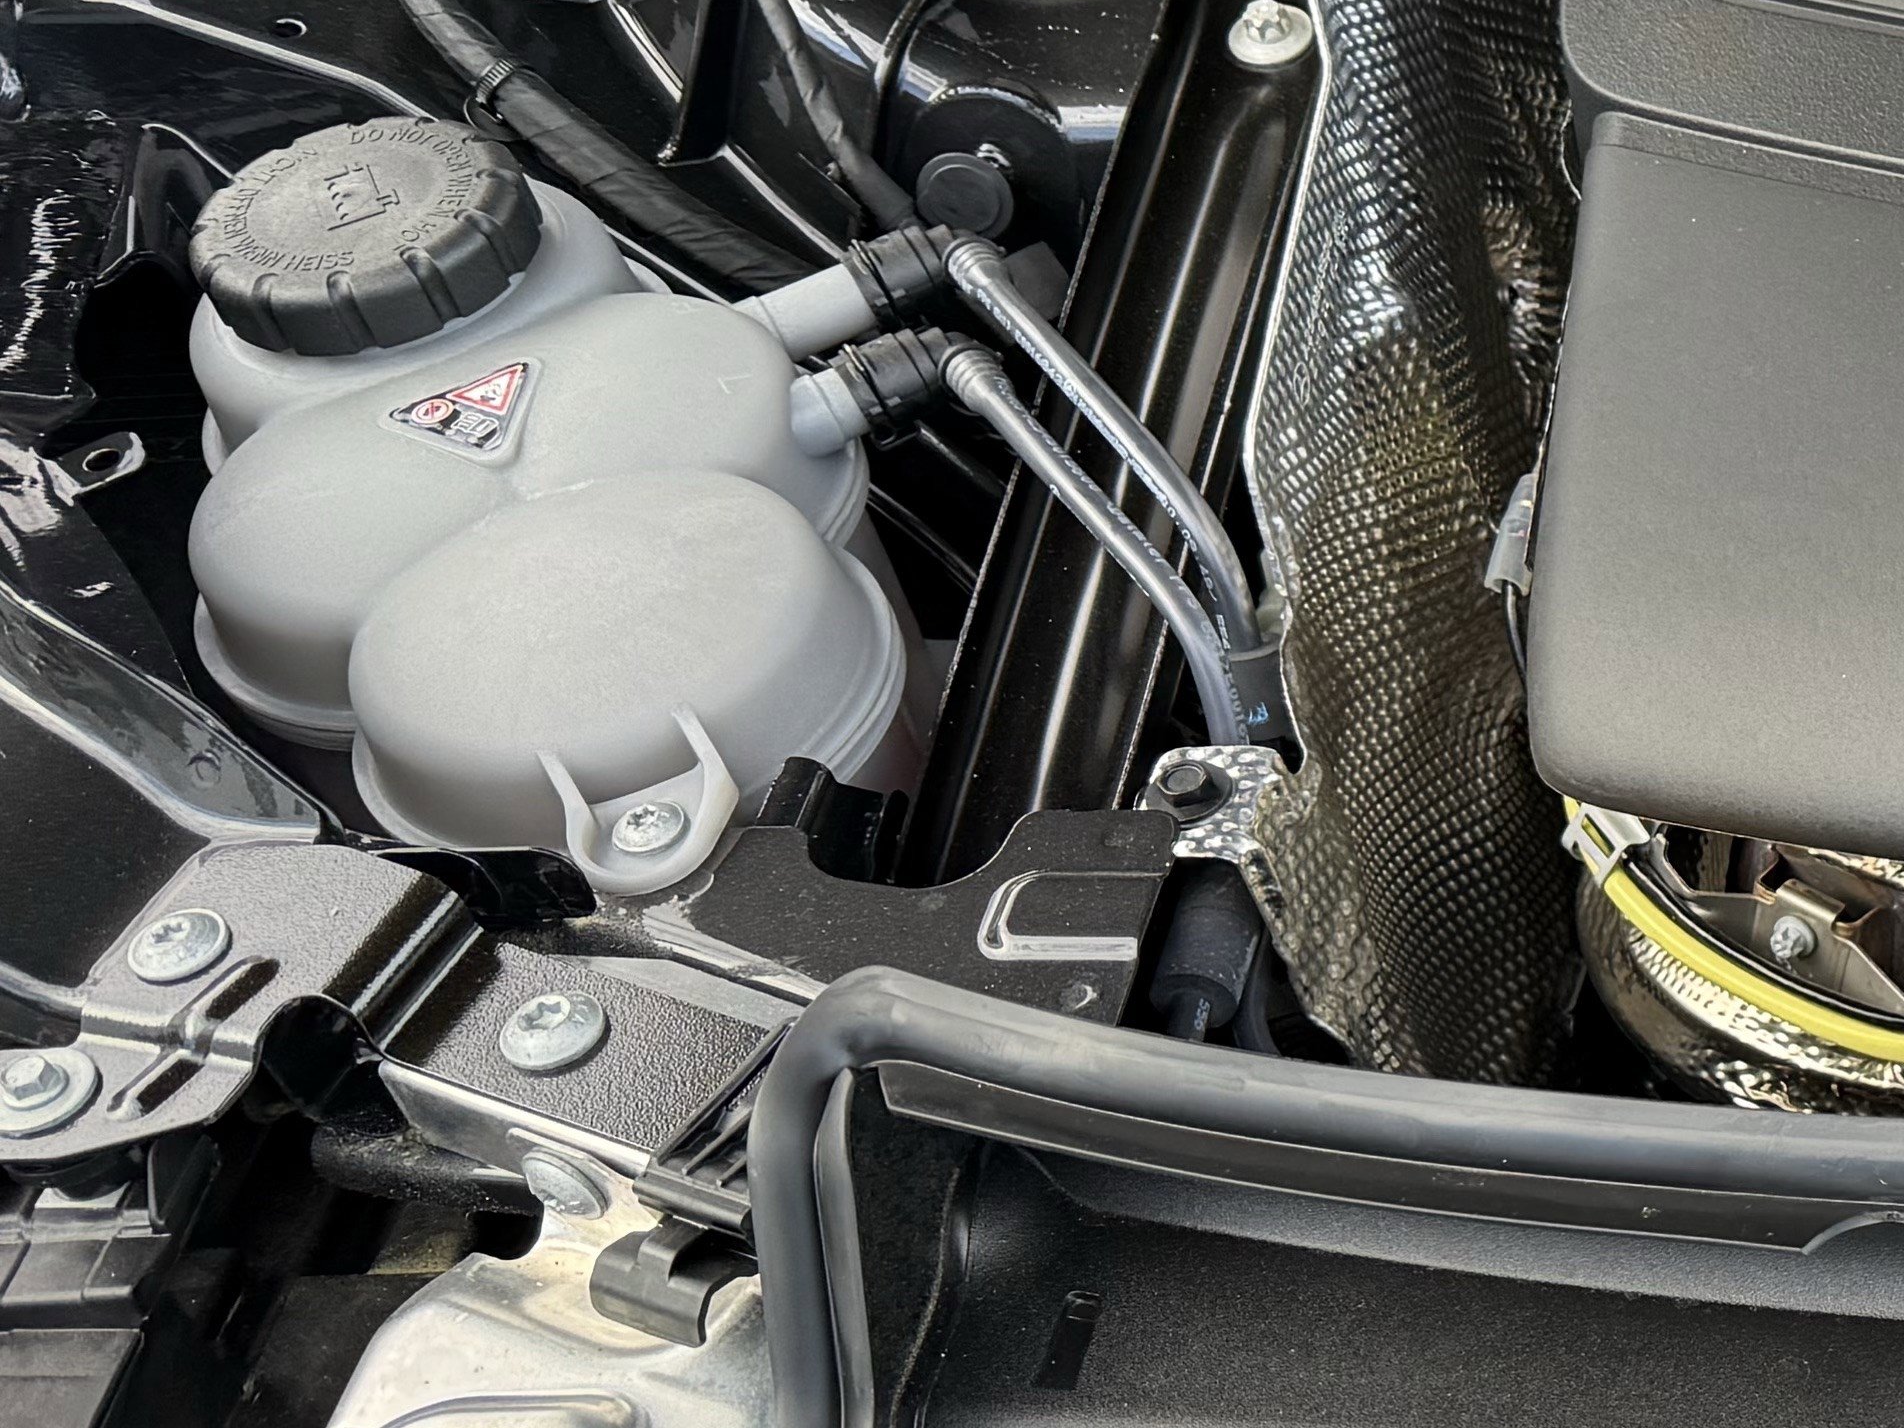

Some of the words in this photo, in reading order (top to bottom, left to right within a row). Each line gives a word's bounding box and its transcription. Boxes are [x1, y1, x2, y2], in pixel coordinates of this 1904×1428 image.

[350, 128, 385, 145] DO
[389, 127, 440, 146] NOT
[282, 251, 355, 272] HEISS
